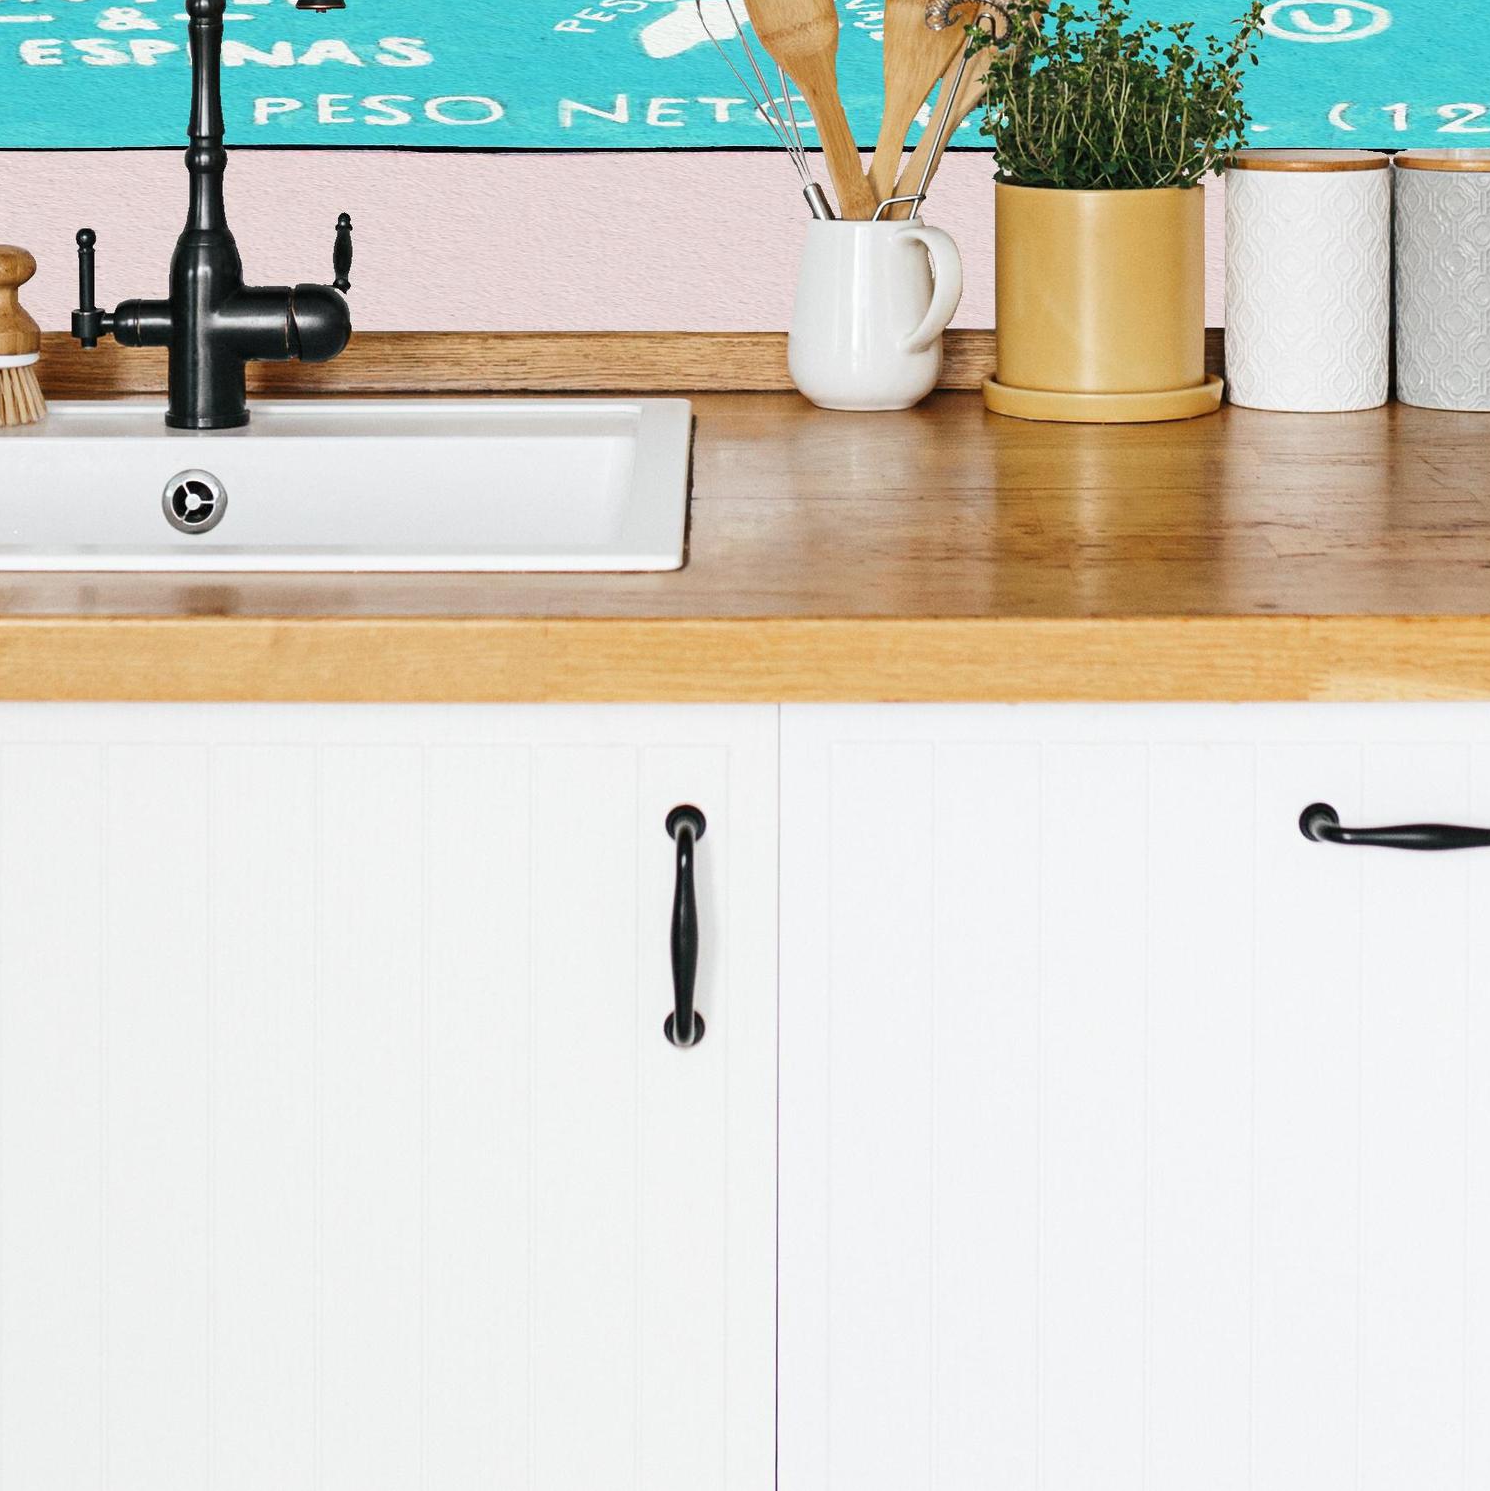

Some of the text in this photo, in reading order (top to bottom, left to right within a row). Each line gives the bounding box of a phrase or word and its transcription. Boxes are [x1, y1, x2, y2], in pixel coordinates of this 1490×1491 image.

[18, 34, 435, 68] ESPNAS
[251, 92, 505, 127] PESO
[556, 92, 817, 129] NETO
